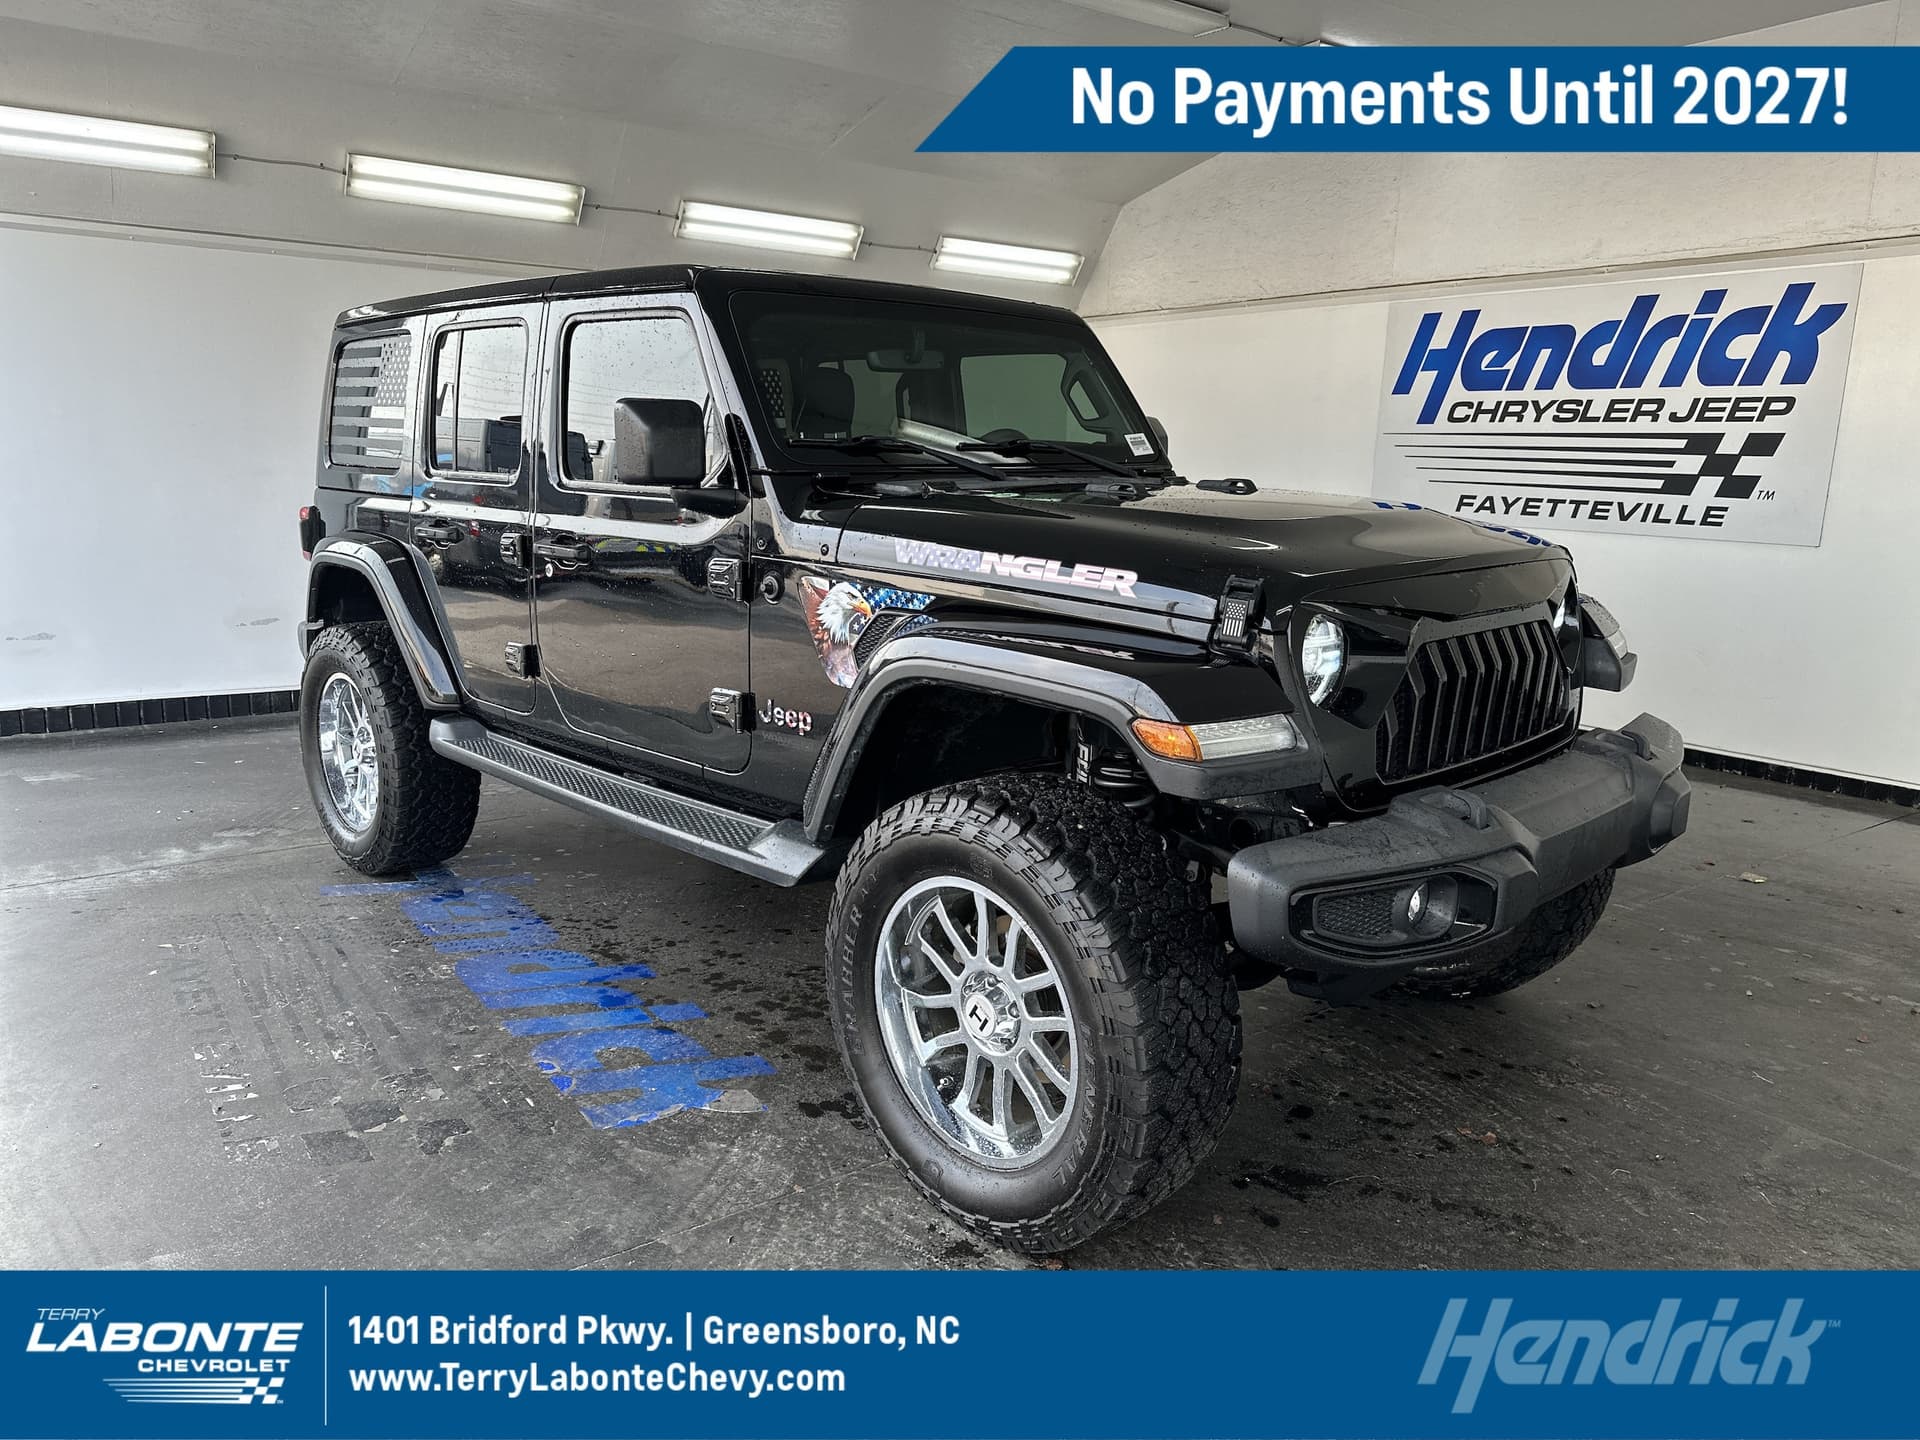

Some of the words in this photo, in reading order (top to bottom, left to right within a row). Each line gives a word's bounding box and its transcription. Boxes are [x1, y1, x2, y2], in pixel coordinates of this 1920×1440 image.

[1391, 281, 1848, 425] Hendrick
[1447, 397, 1668, 424] CHRYSLER
[1669, 396, 1797, 423] JEEP
[1455, 494, 1729, 528] FAYETTEVILLE
[894, 538, 1138, 599] WRANGLER
[758, 698, 812, 736] Jeep
